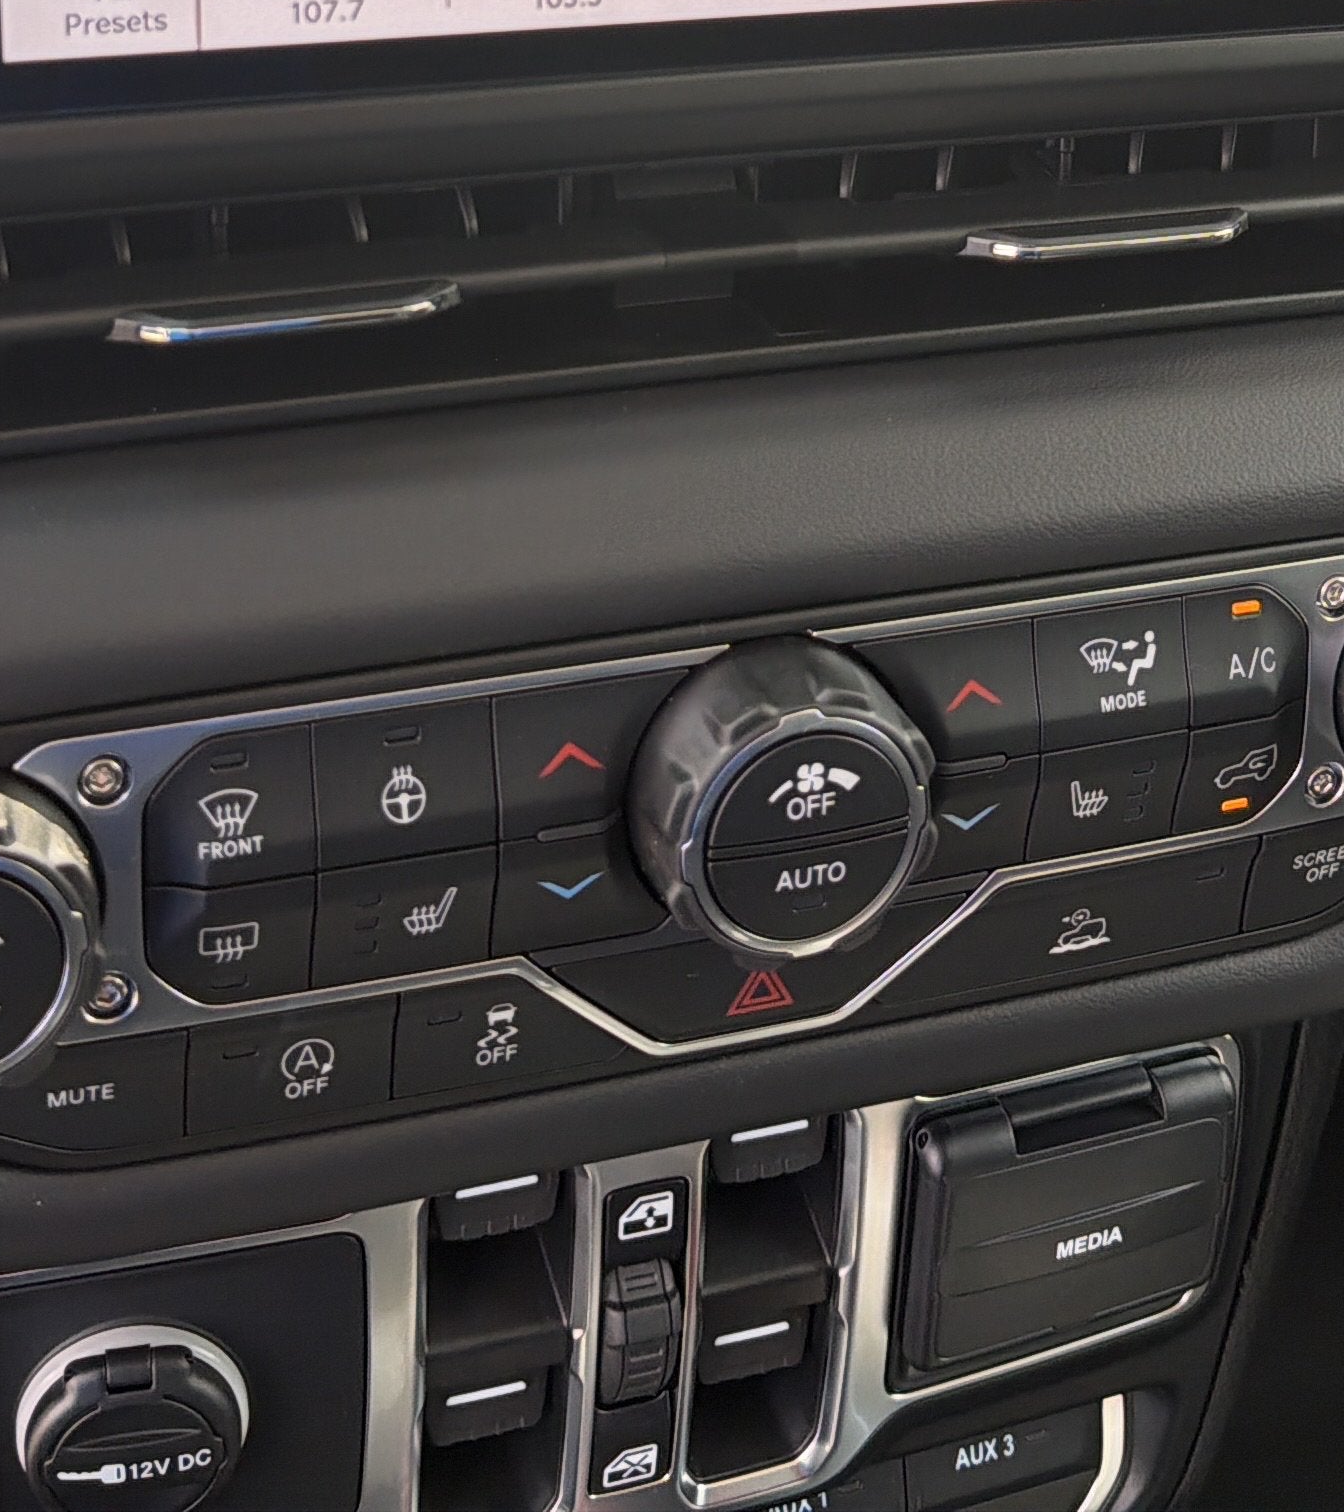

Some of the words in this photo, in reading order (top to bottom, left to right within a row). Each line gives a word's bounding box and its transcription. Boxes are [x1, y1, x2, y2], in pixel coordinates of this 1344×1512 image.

[65, 11, 168, 35] Presets
[1229, 647, 1277, 680] A/C
[1100, 691, 1147, 713] MODE
[786, 791, 837, 822] OFF
[198, 835, 264, 858] FRONT
[775, 860, 846, 892] AUTO
[1307, 862, 1340, 883] OFF
[476, 1043, 519, 1067] OFF
[47, 1083, 115, 1109] MUTE
[285, 1075, 329, 1099] OFF
[1056, 1226, 1123, 1259] MEDIA
[129, 1457, 171, 1481] 12V
[178, 1448, 212, 1472] DC
[955, 1440, 996, 1472] AUX
[1001, 1433, 1016, 1458] 3
